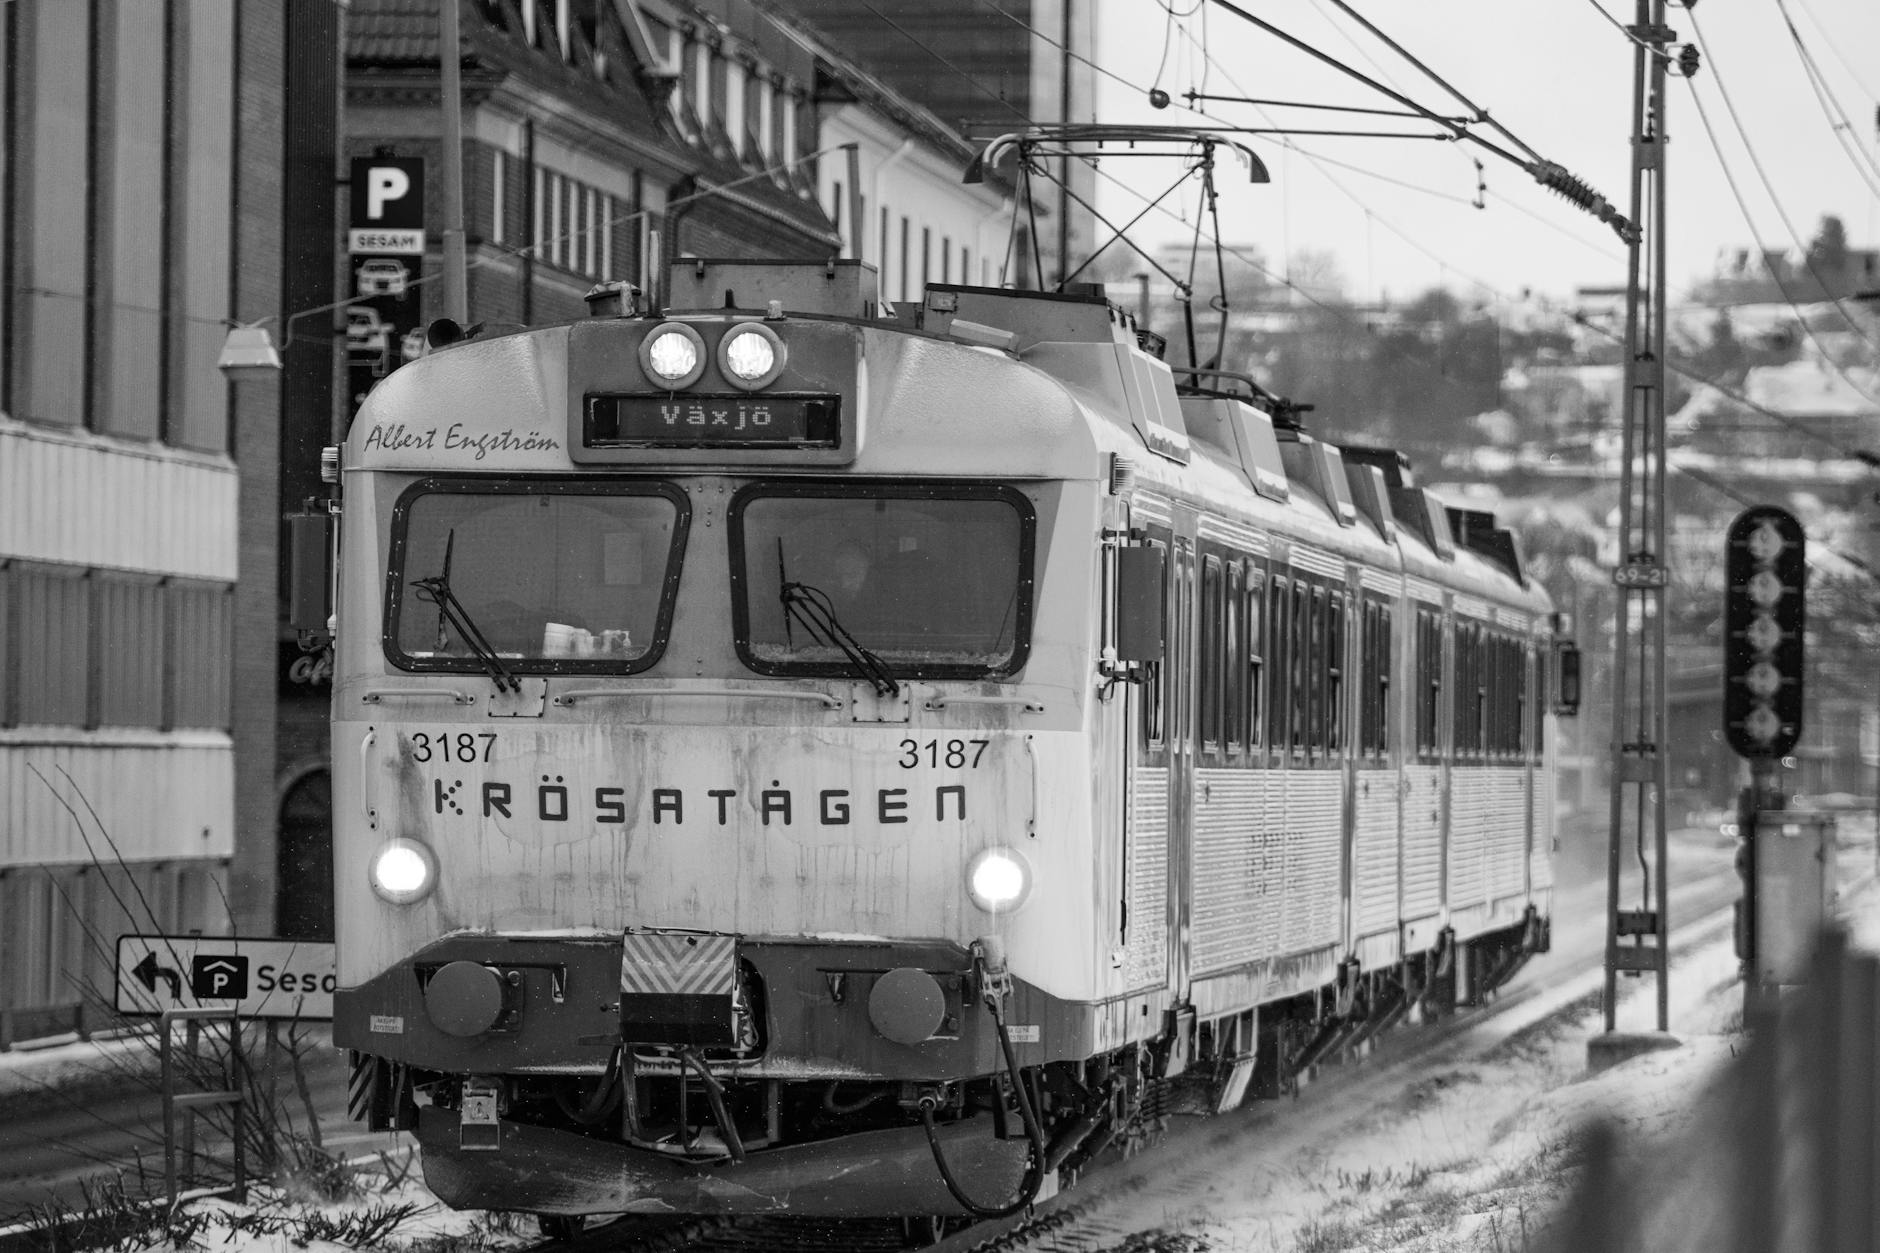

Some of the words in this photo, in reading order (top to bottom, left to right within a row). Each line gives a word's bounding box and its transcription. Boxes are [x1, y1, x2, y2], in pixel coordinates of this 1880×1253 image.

[367, 167, 410, 220] P
[357, 234, 416, 248] SESAM
[661, 405, 771, 430] Växjö
[364, 424, 437, 452] Albert
[444, 423, 560, 460] Engström
[412, 733, 497, 763] 3187
[898, 739, 989, 769] 3187
[434, 774, 966, 826] KRÖSATÅGEN
